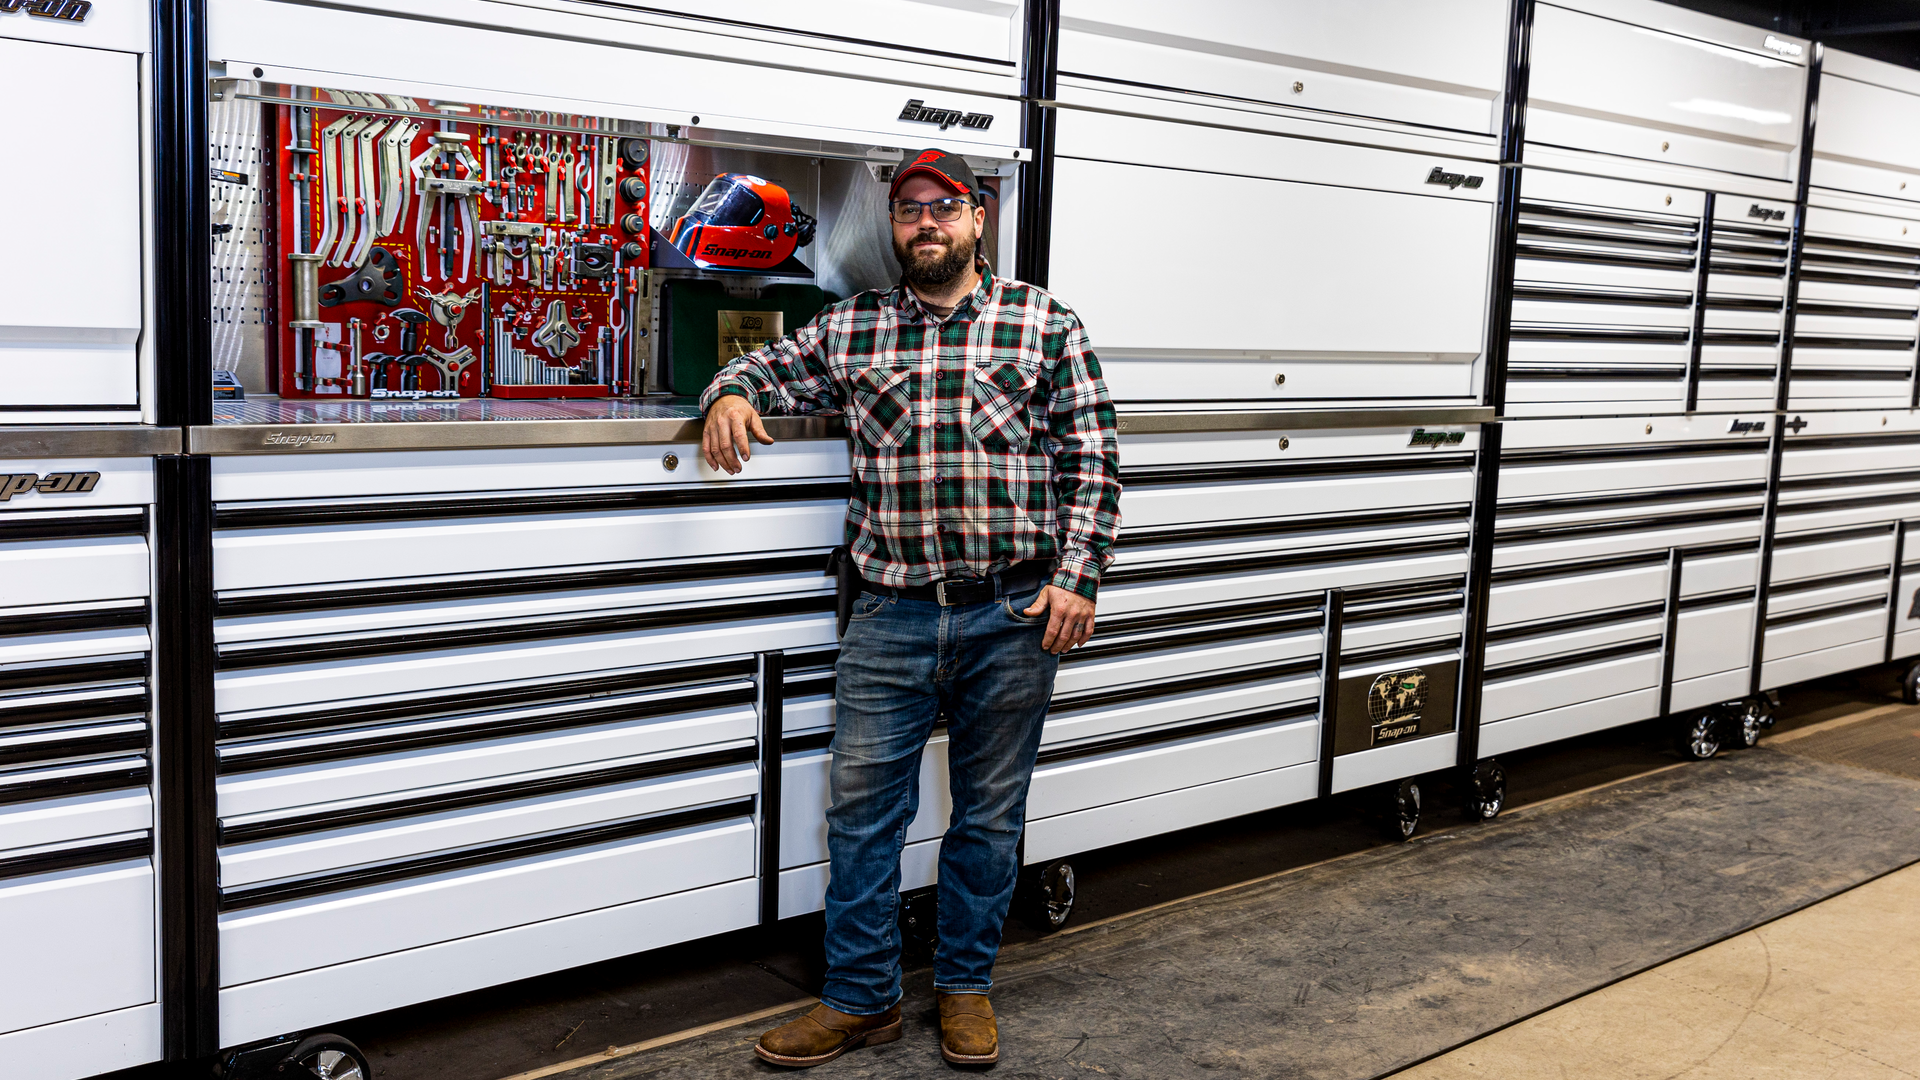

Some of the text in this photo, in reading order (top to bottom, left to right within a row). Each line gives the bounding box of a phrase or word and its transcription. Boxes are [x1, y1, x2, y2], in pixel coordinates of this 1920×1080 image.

[898, 98, 994, 130] Snap-on
[1425, 166, 1484, 190] Snap-on
[701, 243, 772, 260] Snap-on
[371, 388, 460, 400] Snap-on
[263, 432, 336, 447] Snap-on
[1407, 428, 1466, 449] Snap-on
[1377, 724, 1418, 740] Snap-on
